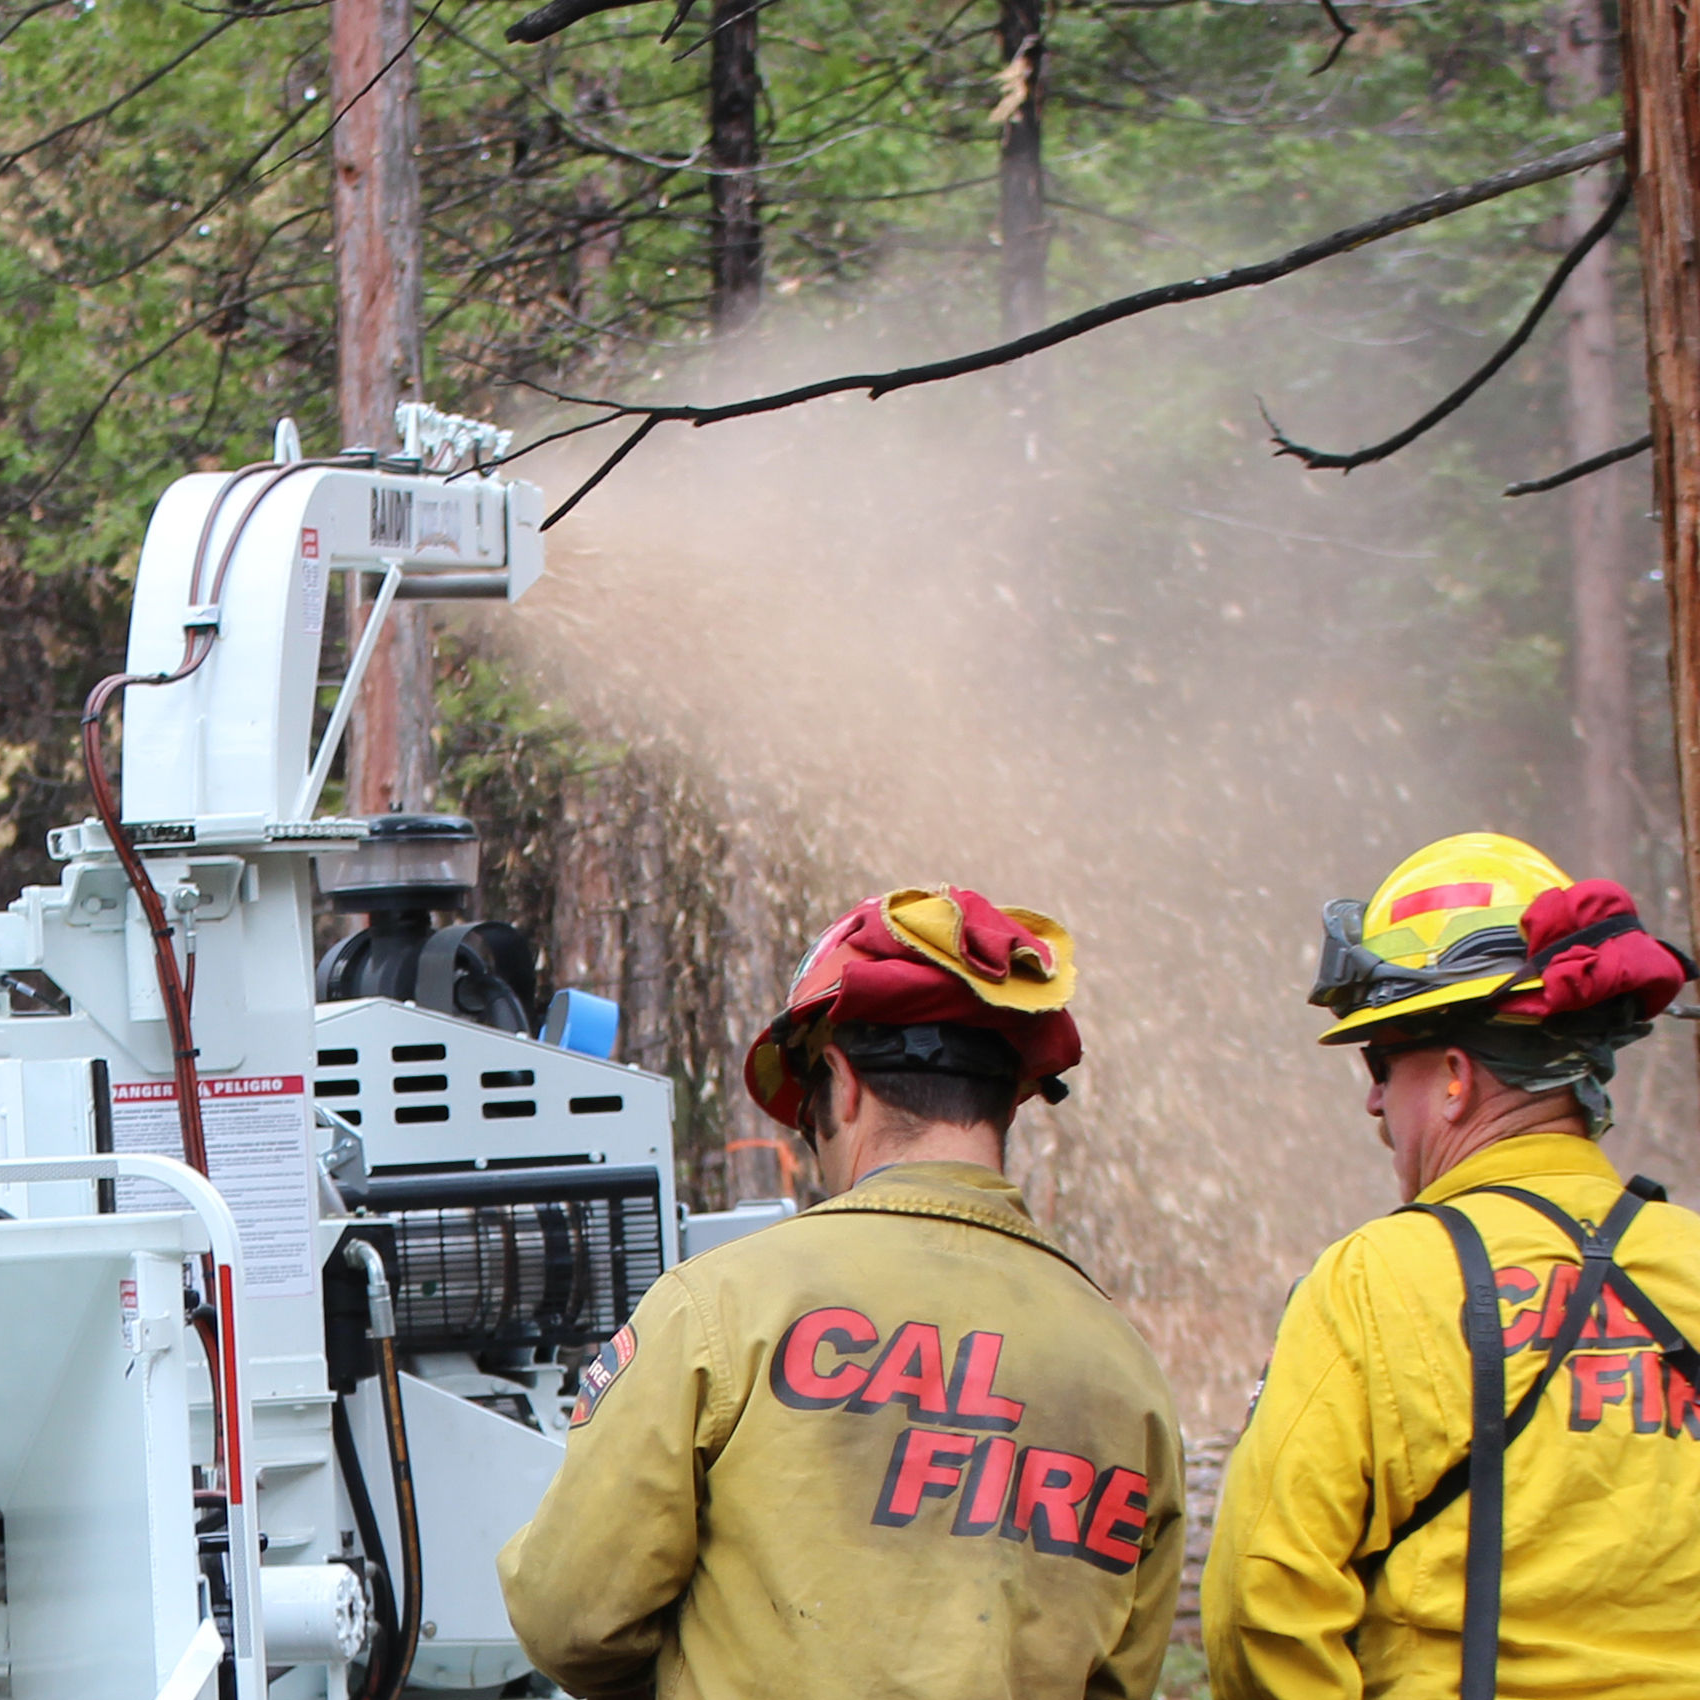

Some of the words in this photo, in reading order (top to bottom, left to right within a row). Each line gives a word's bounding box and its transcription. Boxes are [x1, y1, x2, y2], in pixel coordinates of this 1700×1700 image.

[213, 1078, 284, 1094] PELIGRO
[587, 1354, 612, 1389] IRE
[769, 1306, 1026, 1432] CAL
[871, 1426, 1150, 1576] FIRE
